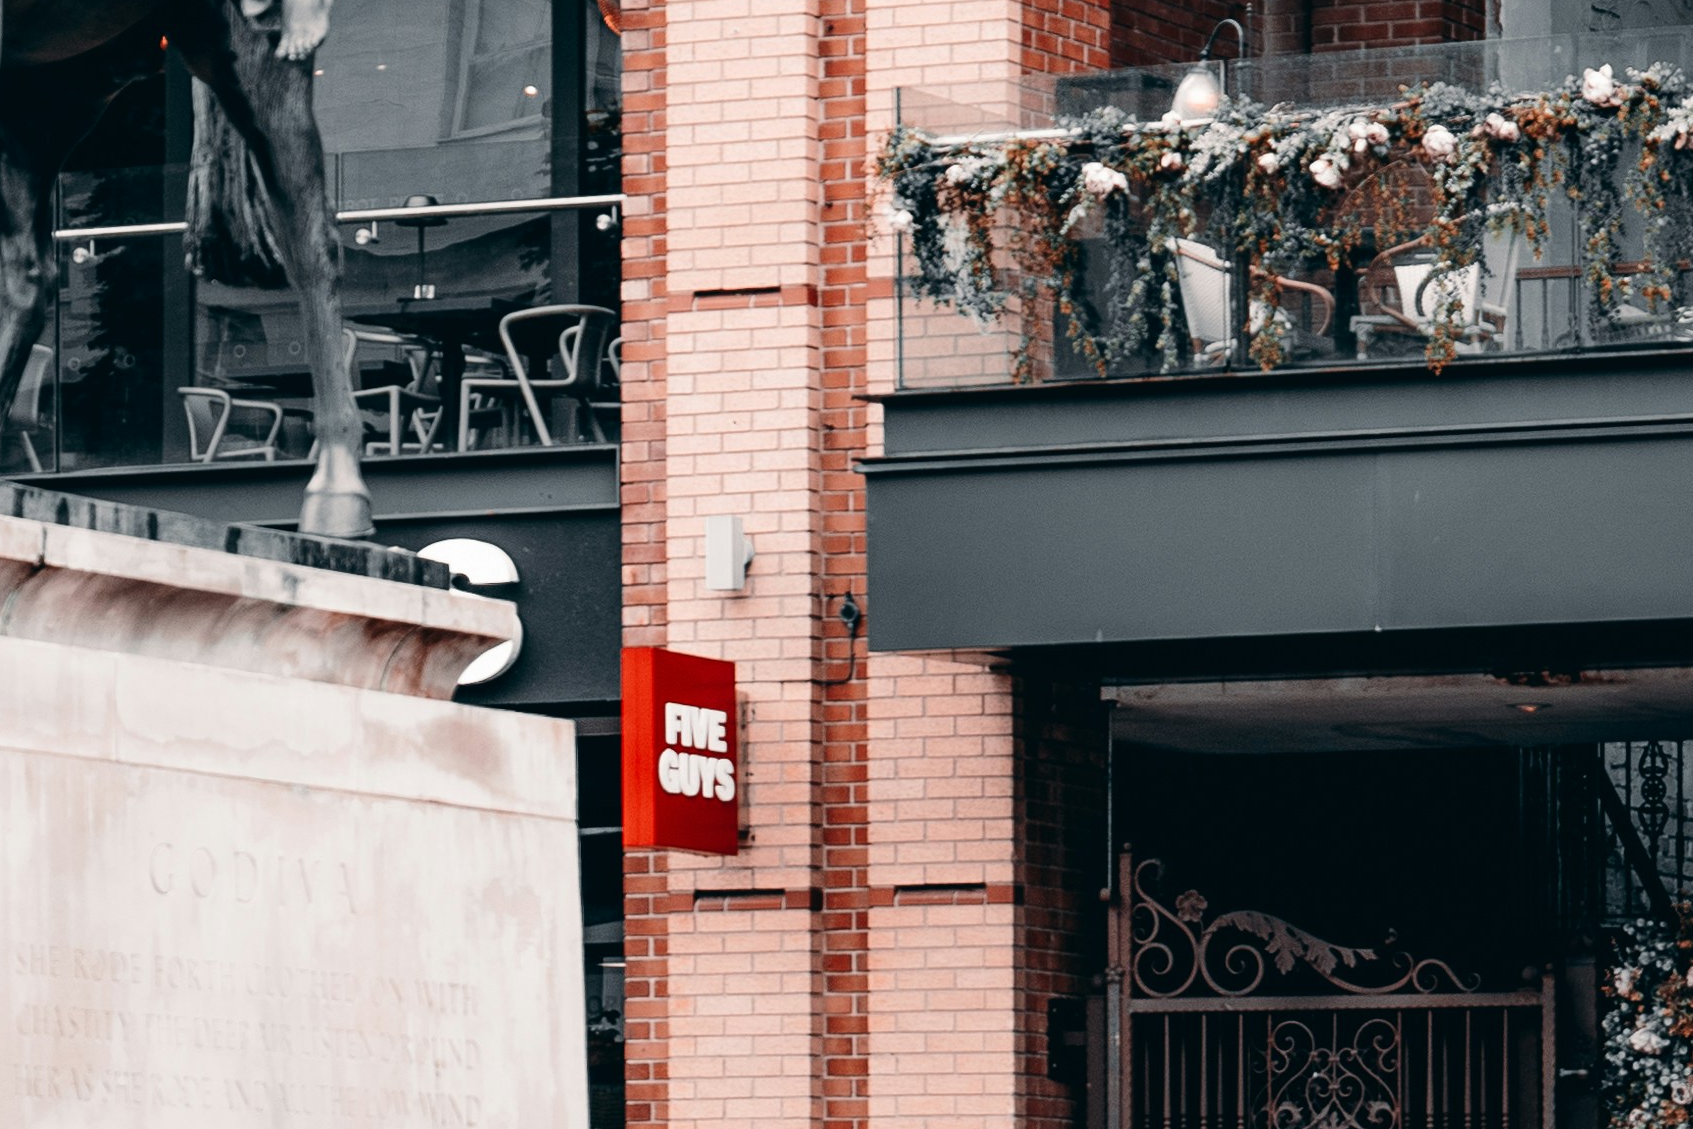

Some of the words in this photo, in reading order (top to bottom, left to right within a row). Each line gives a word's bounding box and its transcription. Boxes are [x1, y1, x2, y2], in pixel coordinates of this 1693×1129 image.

[665, 701, 728, 753] FIVE
[658, 748, 736, 802] GUYS
[149, 842, 358, 914] GODIVA
[14, 942, 60, 978] SHE
[73, 948, 142, 985] RODE
[153, 954, 237, 994] FORTH
[415, 977, 479, 1016] WITH
[16, 1003, 132, 1042] CHASTITY
[144, 1012, 187, 1048] THE
[193, 1015, 250, 1052] DEEP
[14, 1062, 62, 1099] HER
